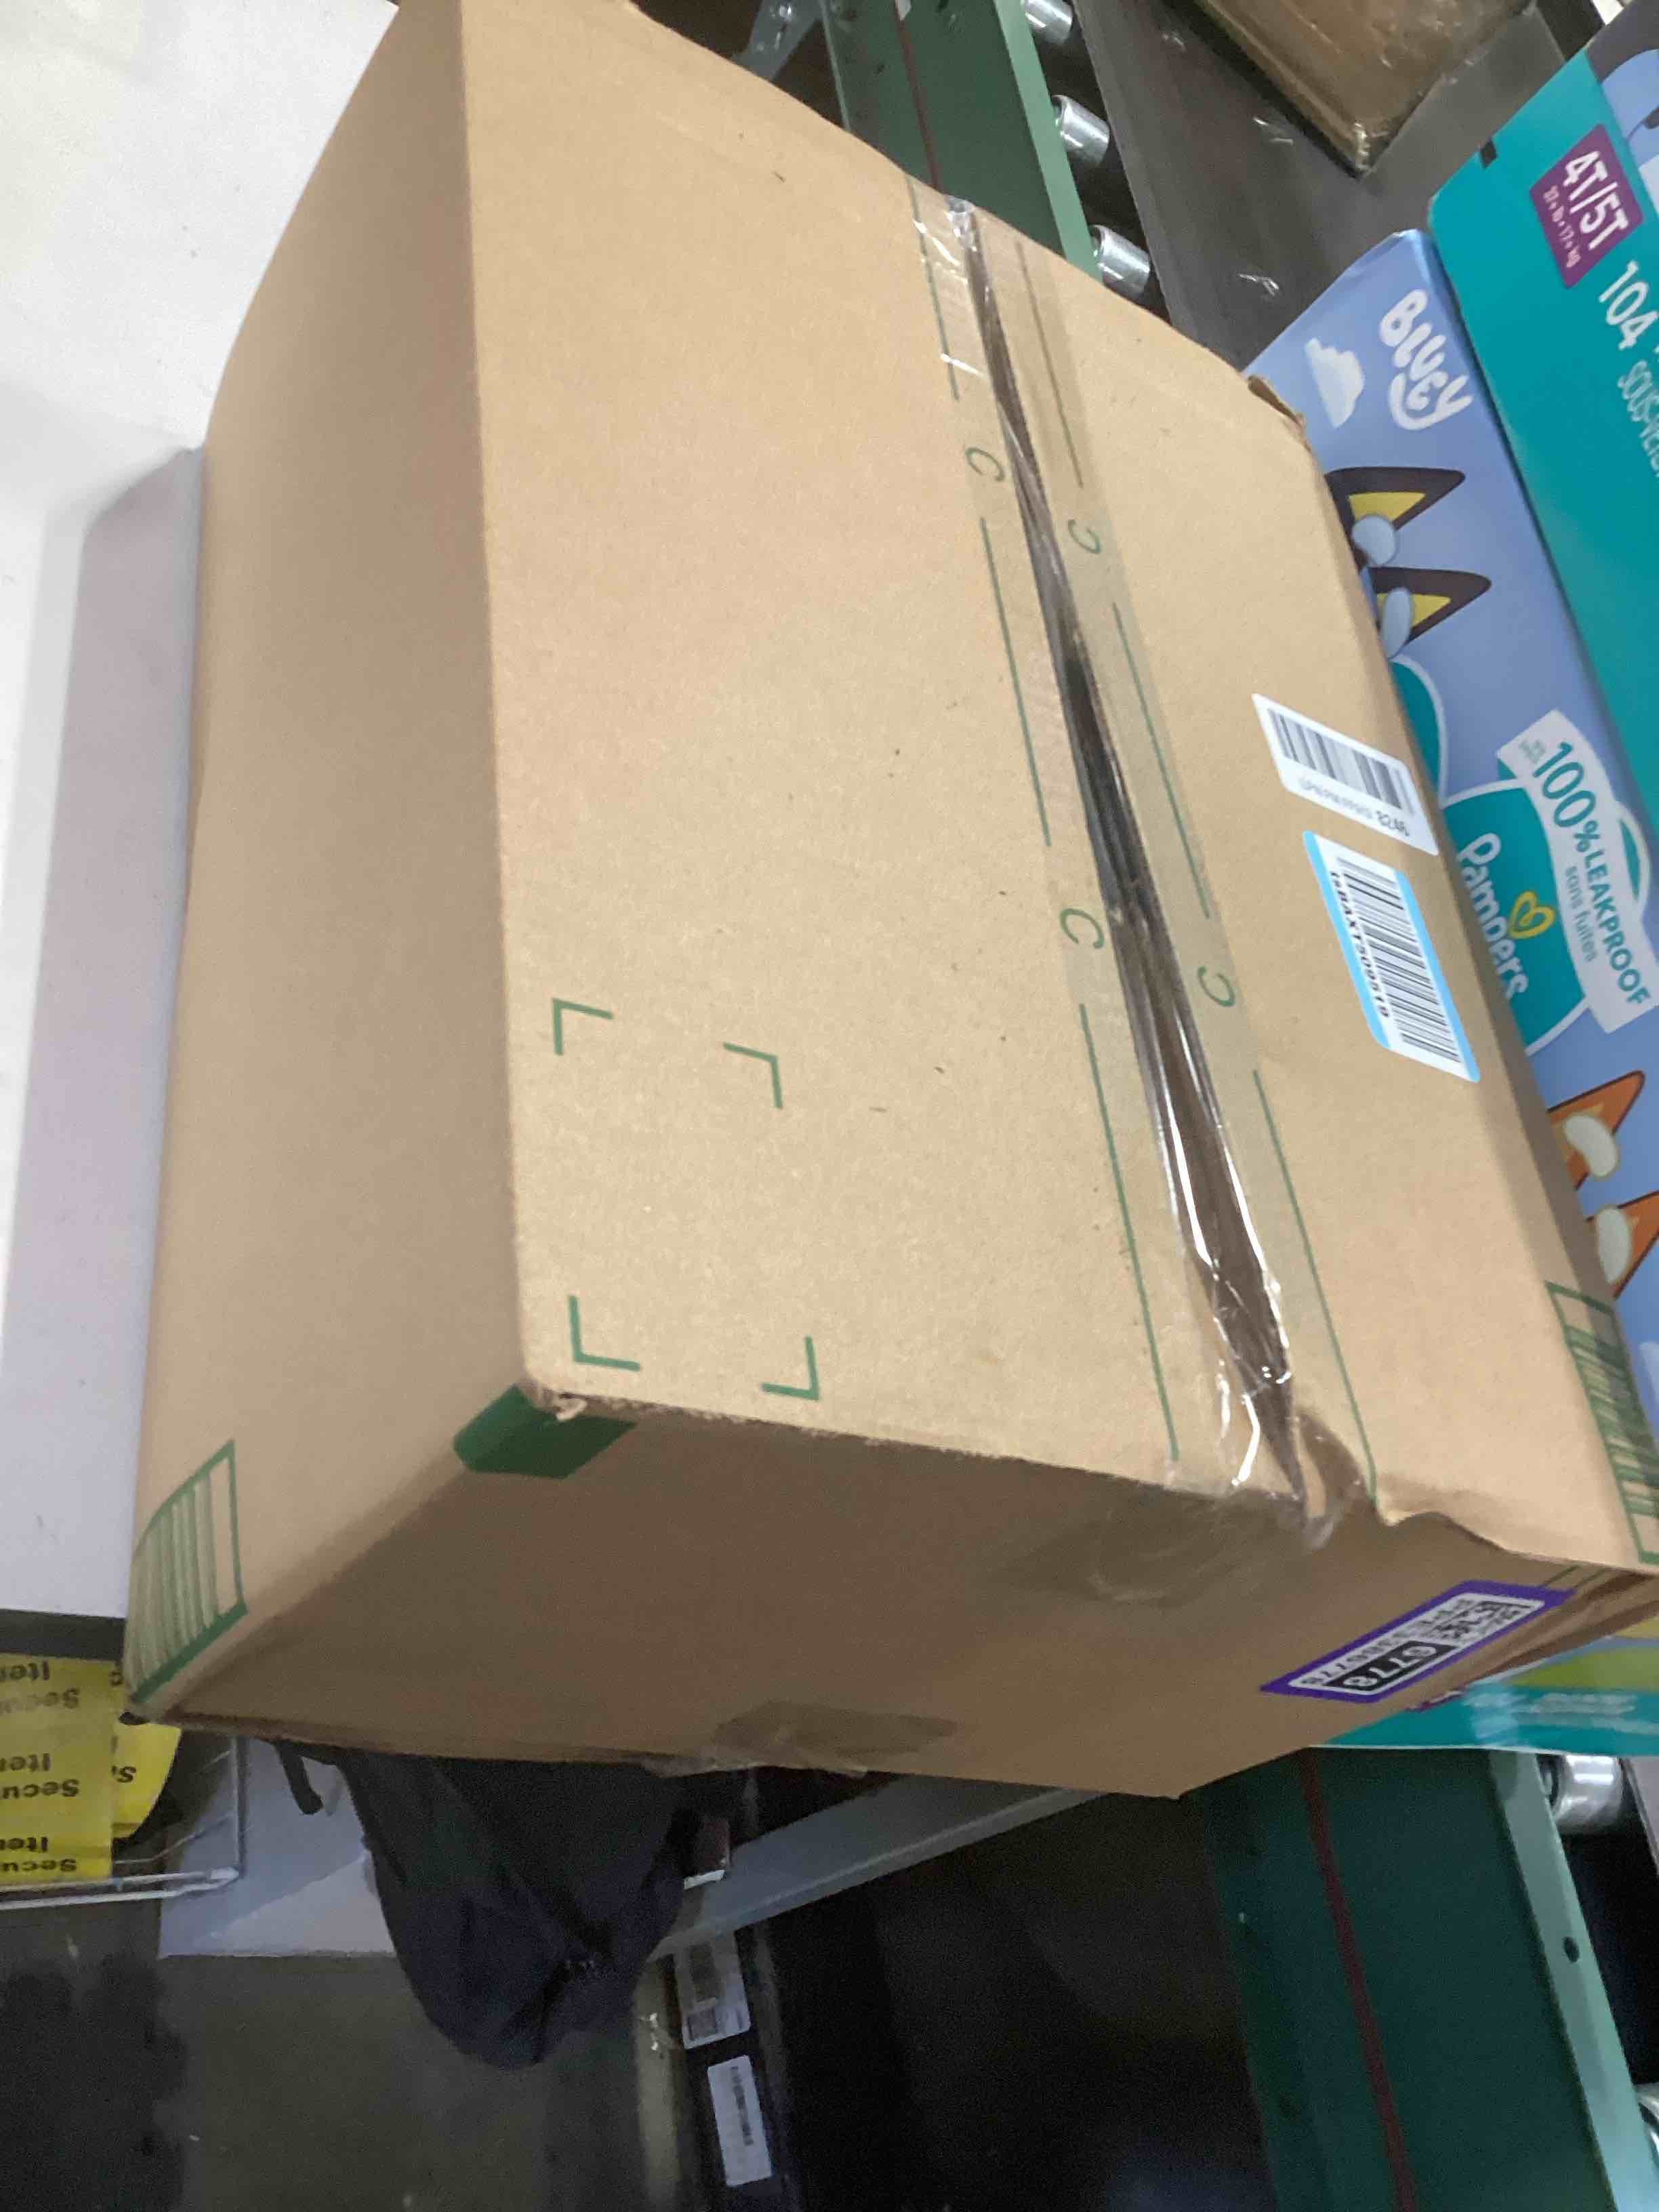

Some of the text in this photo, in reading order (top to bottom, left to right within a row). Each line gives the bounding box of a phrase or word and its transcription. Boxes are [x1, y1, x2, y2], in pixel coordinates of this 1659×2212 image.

[1563, 150, 1629, 250] 4T/5T
[1378, 289, 1474, 430] Bluey
[1598, 261, 1658, 350] 104
[1457, 832, 1530, 1000] Pampers
[1532, 741, 1601, 853] 100%
[1584, 849, 1652, 1004] LEAKPROOF
[1565, 865, 1584, 909] sans
